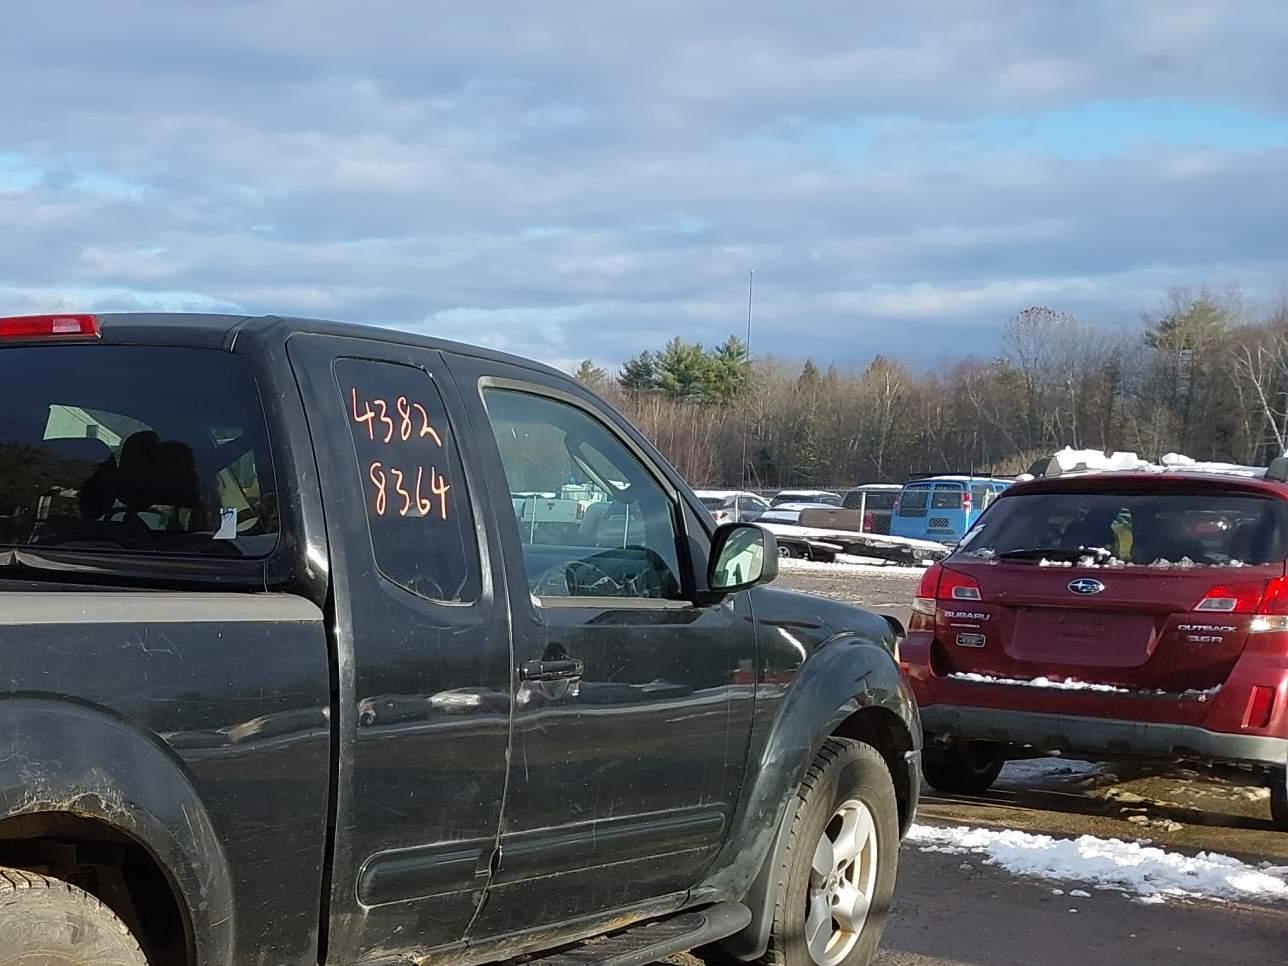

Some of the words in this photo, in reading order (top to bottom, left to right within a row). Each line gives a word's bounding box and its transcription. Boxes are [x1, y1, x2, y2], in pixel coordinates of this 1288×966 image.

[352, 387, 442, 447] 4382
[370, 462, 451, 520] 8364
[944, 610, 991, 621] SUBARU
[1178, 624, 1238, 633] OUTBACK
